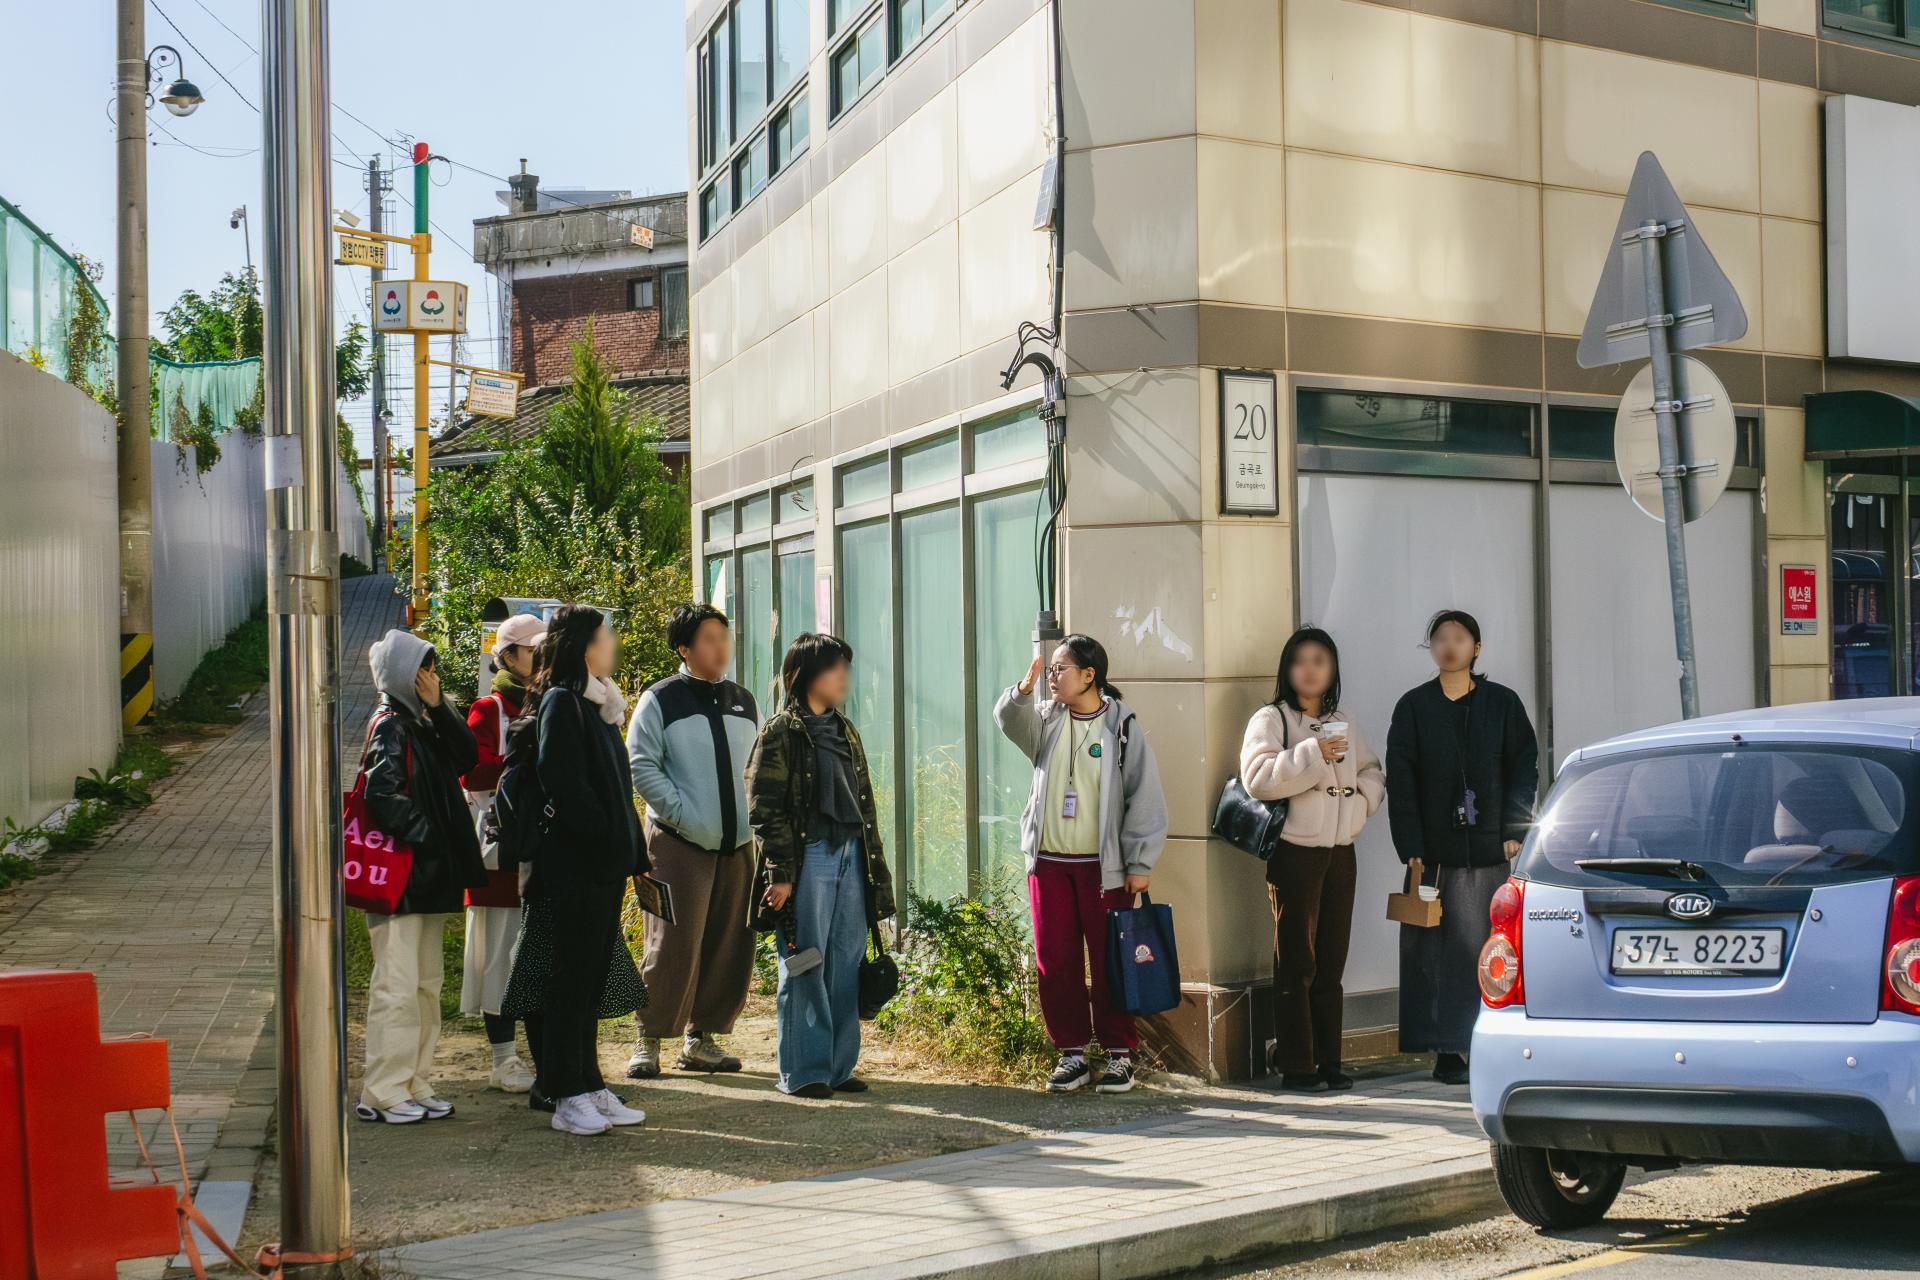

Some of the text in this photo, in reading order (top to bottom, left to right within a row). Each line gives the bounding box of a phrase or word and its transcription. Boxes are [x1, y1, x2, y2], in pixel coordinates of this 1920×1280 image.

[1233, 403, 1267, 440] 20
[1239, 463, 1263, 476] 금곡로
[1788, 585, 1812, 603] 에스원
[1675, 899, 1705, 911] KIA
[1528, 906, 1580, 922] morning
[1627, 934, 1766, 964] 37노 8223
